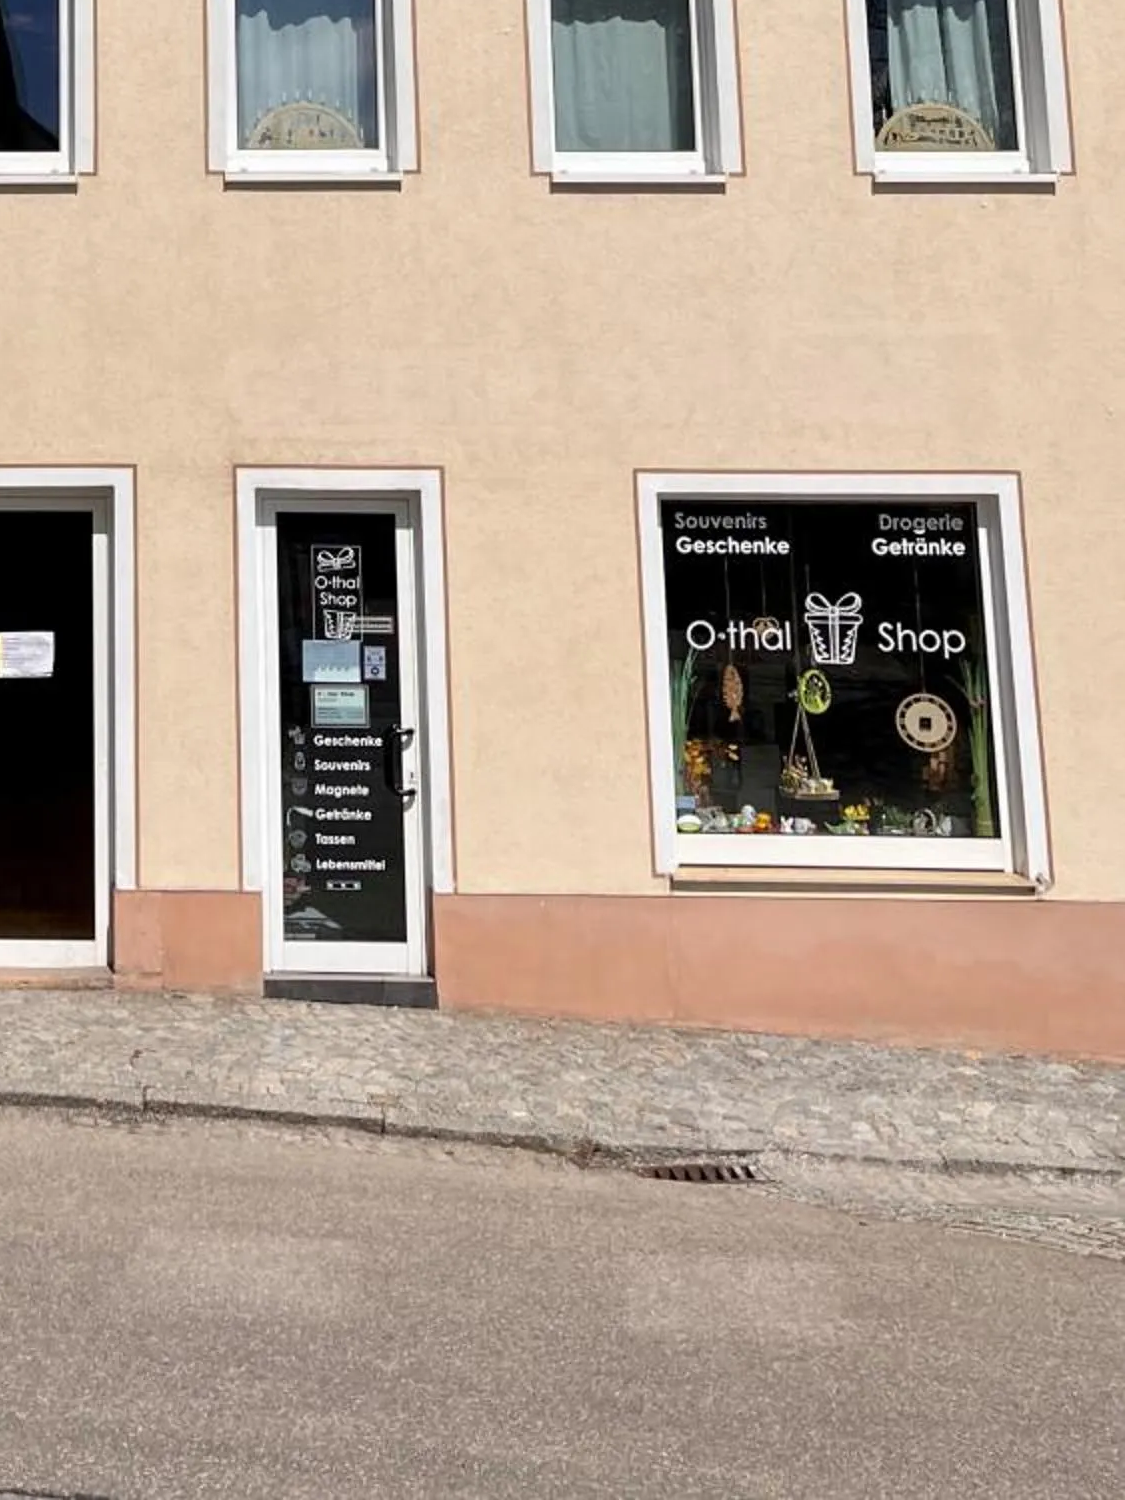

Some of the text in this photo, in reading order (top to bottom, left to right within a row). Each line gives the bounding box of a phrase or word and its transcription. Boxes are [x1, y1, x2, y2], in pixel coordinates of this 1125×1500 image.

[674, 511, 768, 530] Souvenirs
[878, 513, 964, 535] Drogerie
[675, 536, 790, 555] Geschenke
[871, 537, 966, 557] Getränke
[319, 591, 358, 608] Shop
[878, 622, 966, 659] Shop
[313, 734, 383, 747] Geschenke
[314, 758, 371, 772] Souvenirs
[314, 783, 370, 798] Magnete
[315, 806, 372, 821] Getränke
[314, 832, 356, 845] Tassen
[316, 858, 386, 871] Lebensmittel
